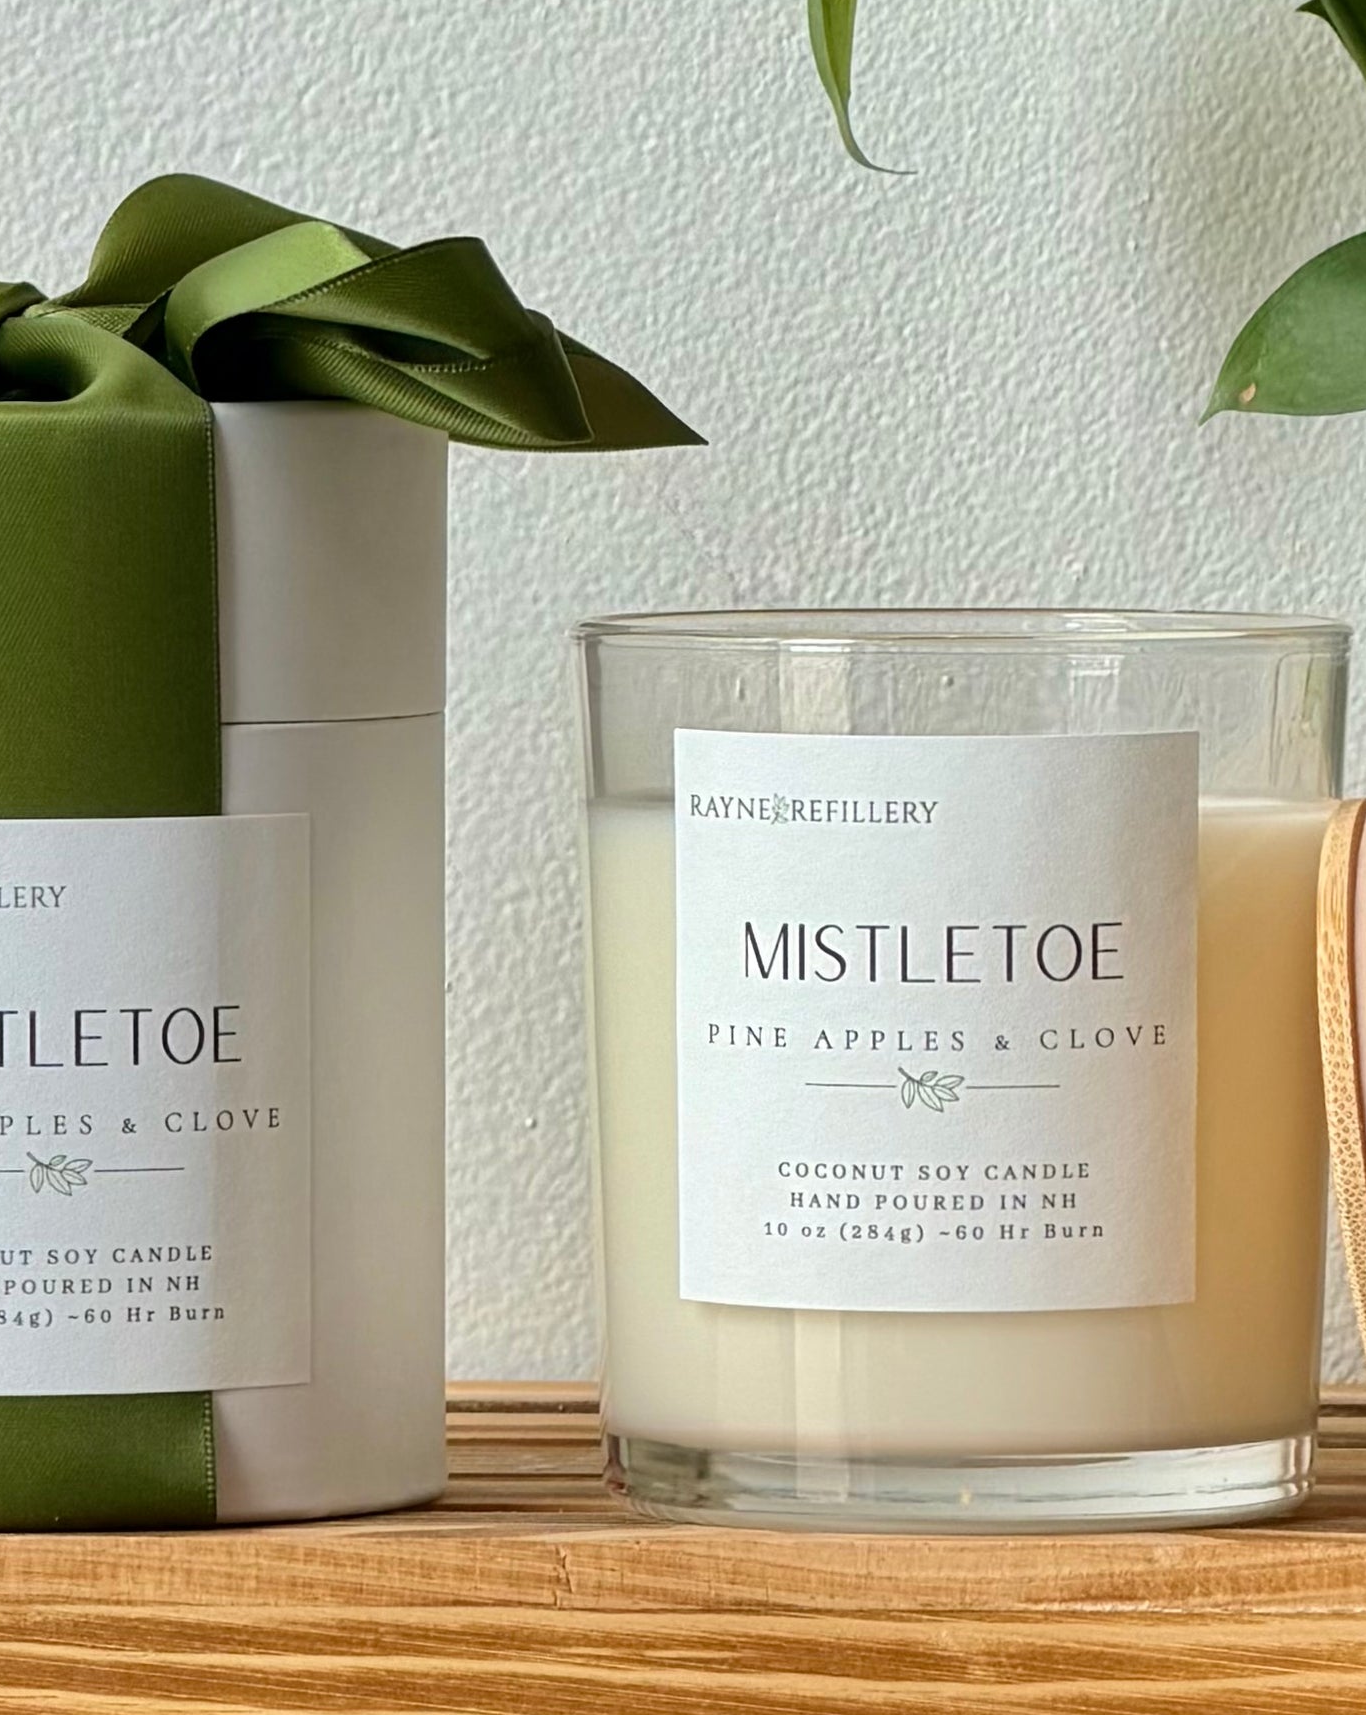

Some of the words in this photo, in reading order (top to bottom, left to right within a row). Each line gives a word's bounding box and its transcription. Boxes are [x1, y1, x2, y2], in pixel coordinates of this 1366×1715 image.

[690, 793, 771, 821] RAYNE
[791, 799, 939, 824] REFILLERY
[745, 921, 1125, 984] MISTLETOE
[708, 1023, 787, 1048] PINE
[813, 1029, 965, 1052] APPLES
[994, 1034, 1010, 1051] &
[1039, 1024, 1166, 1050] CLOVE
[121, 1117, 137, 1135] &
[164, 1107, 280, 1133] CLOVE
[778, 1161, 904, 1181] COCONUT
[918, 1164, 970, 1182] SOY
[984, 1162, 1090, 1181] CANDLE
[790, 1191, 861, 1210] HAND
[875, 1194, 985, 1211] POURED
[1000, 1194, 1027, 1211] IN
[1041, 1192, 1076, 1210] NH
[764, 1221, 788, 1237] 10
[800, 1226, 826, 1239] oz
[839, 1222, 924, 1245] (284g)
[939, 1224, 985, 1241] ~60
[999, 1223, 1030, 1240] Hr
[1044, 1223, 1104, 1239] Burn
[46, 1248, 98, 1265] SOY
[112, 1244, 212, 1264] CANDLE
[4, 1277, 113, 1296] POURED
[126, 1276, 153, 1294] IN
[166, 1275, 200, 1292] NH
[67, 1308, 112, 1324] ~60
[126, 1306, 156, 1323] Hr
[169, 1305, 225, 1322] Burn
